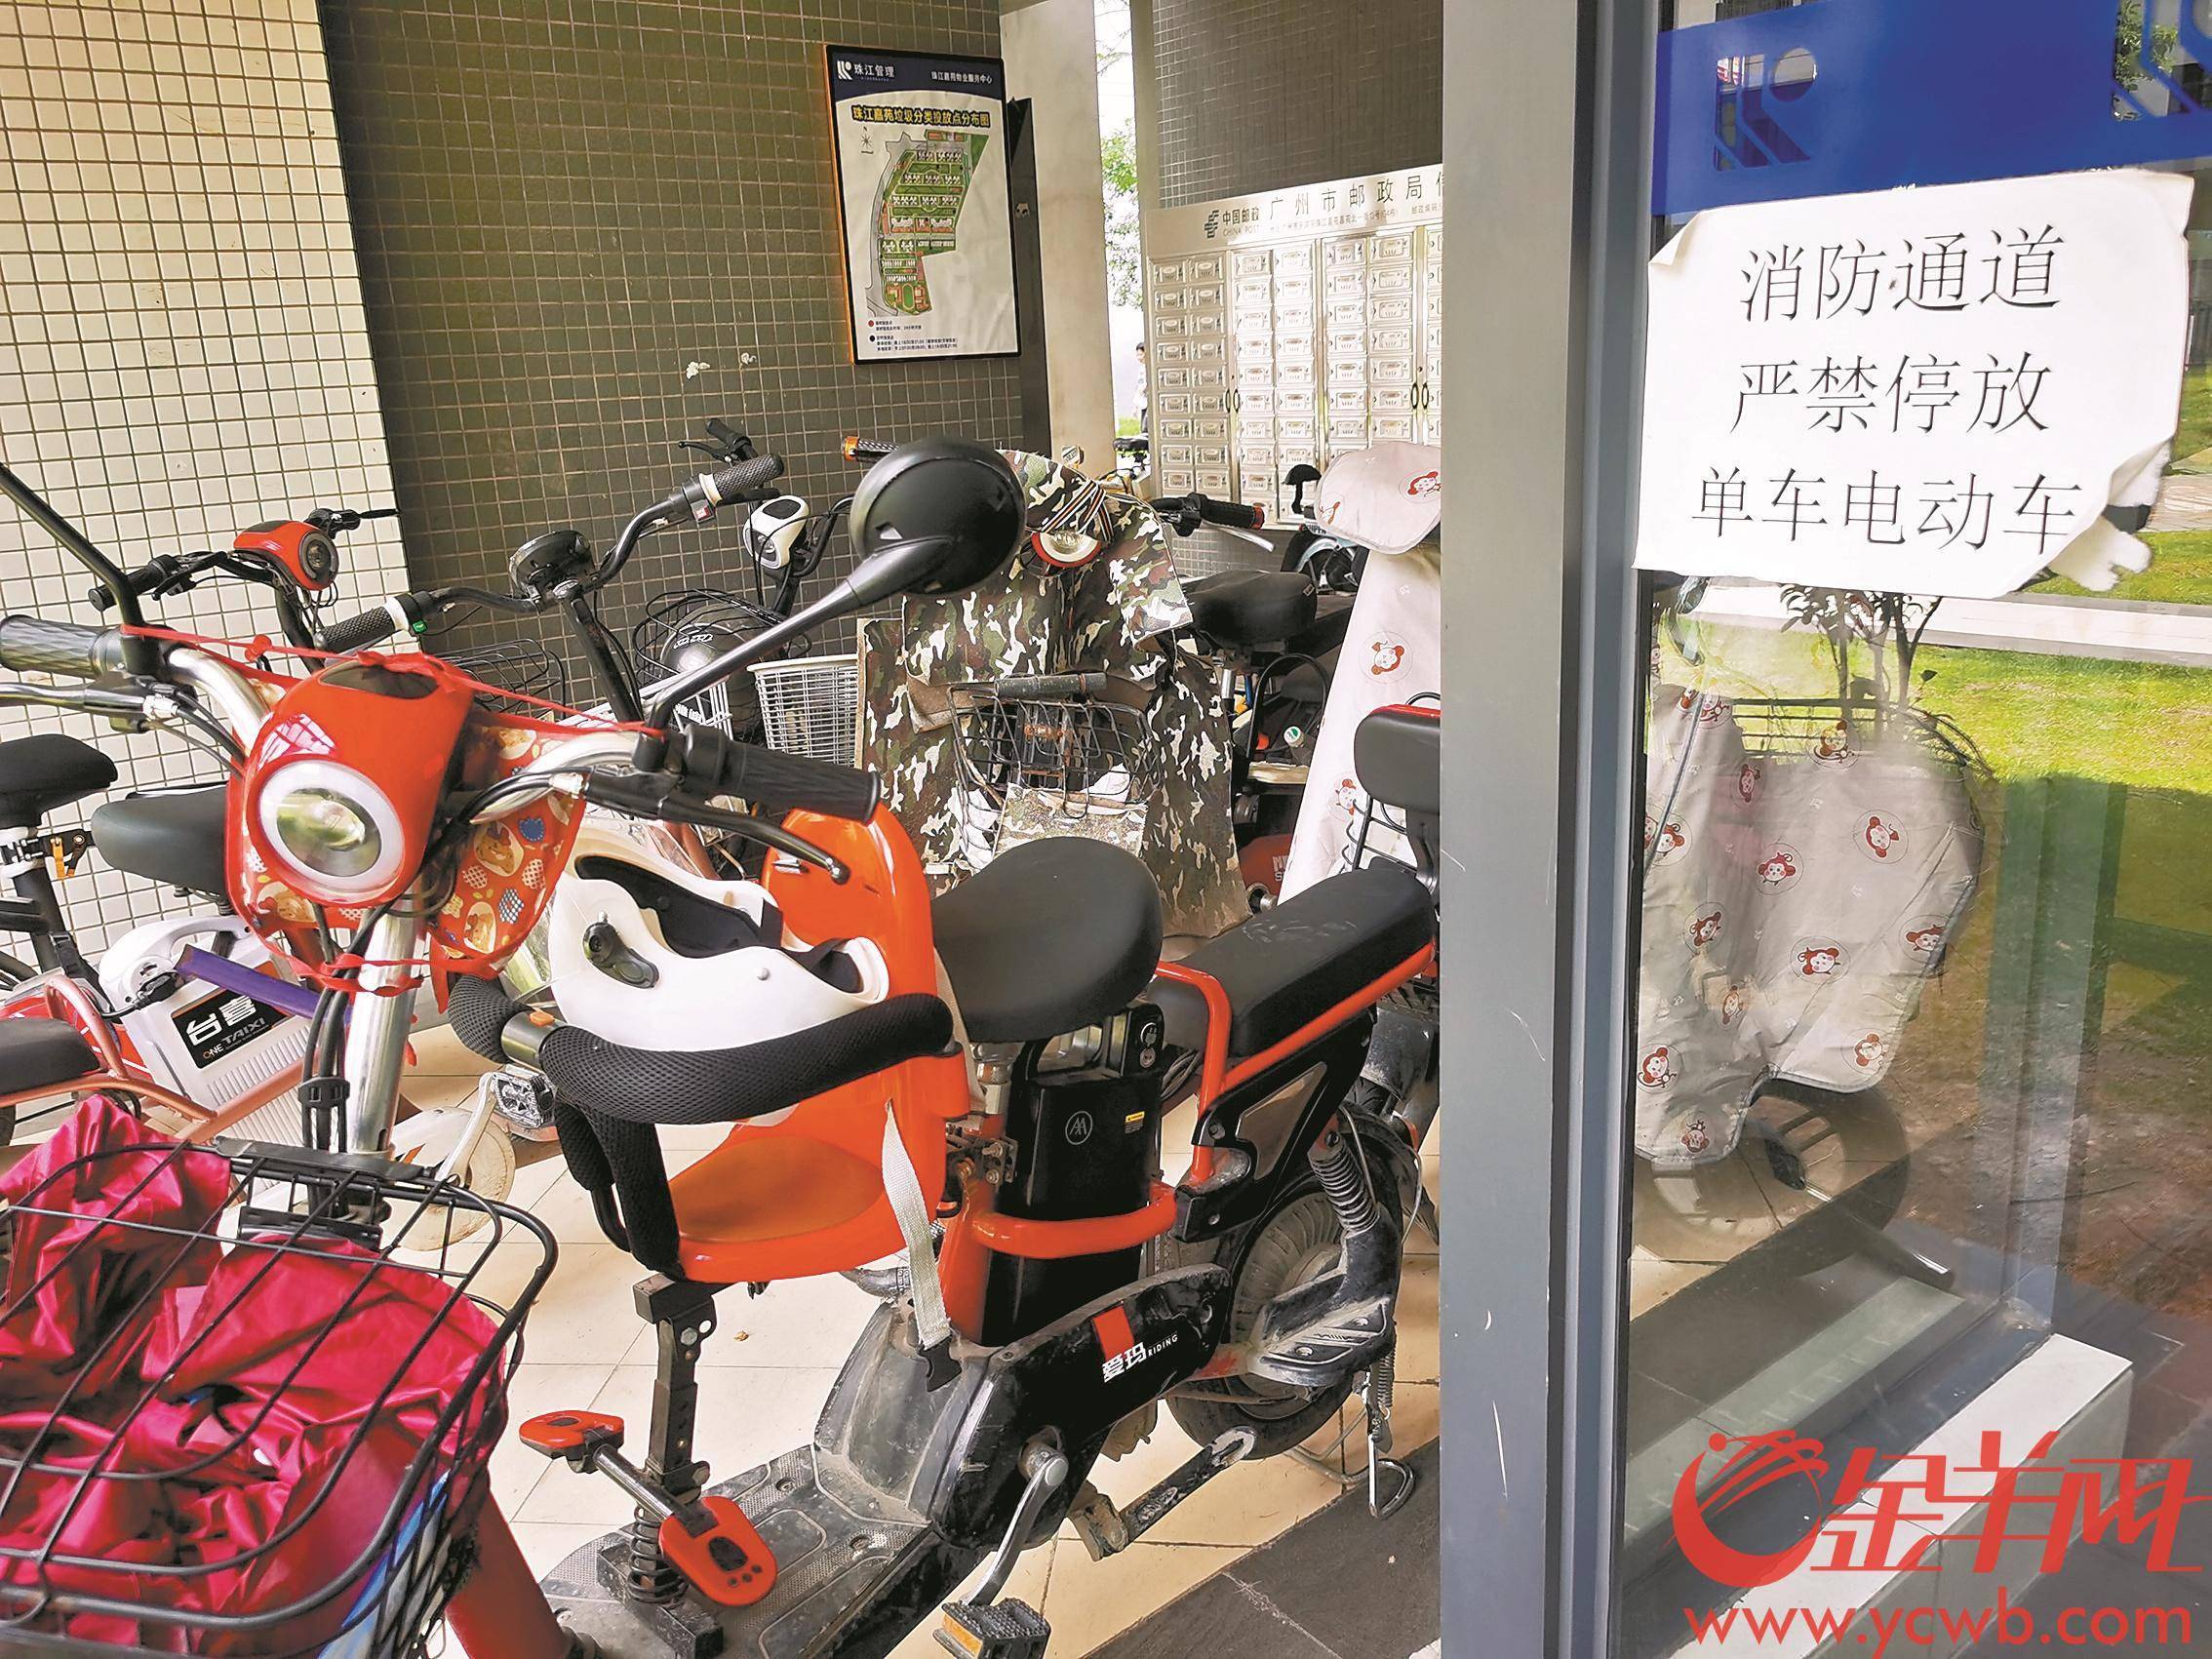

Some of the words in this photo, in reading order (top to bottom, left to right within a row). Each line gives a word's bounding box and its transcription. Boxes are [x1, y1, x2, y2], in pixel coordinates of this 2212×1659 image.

[853, 63, 894, 78] 珠江管理
[1222, 206, 1260, 225] 中国邮政
[1739, 224, 2065, 323] 消防通道
[1730, 351, 2052, 435] 严禁停放
[1691, 466, 2082, 555] 单车电动车
[1101, 1341, 1148, 1383] 爱玛
[1147, 1334, 1179, 1358] RIDING
